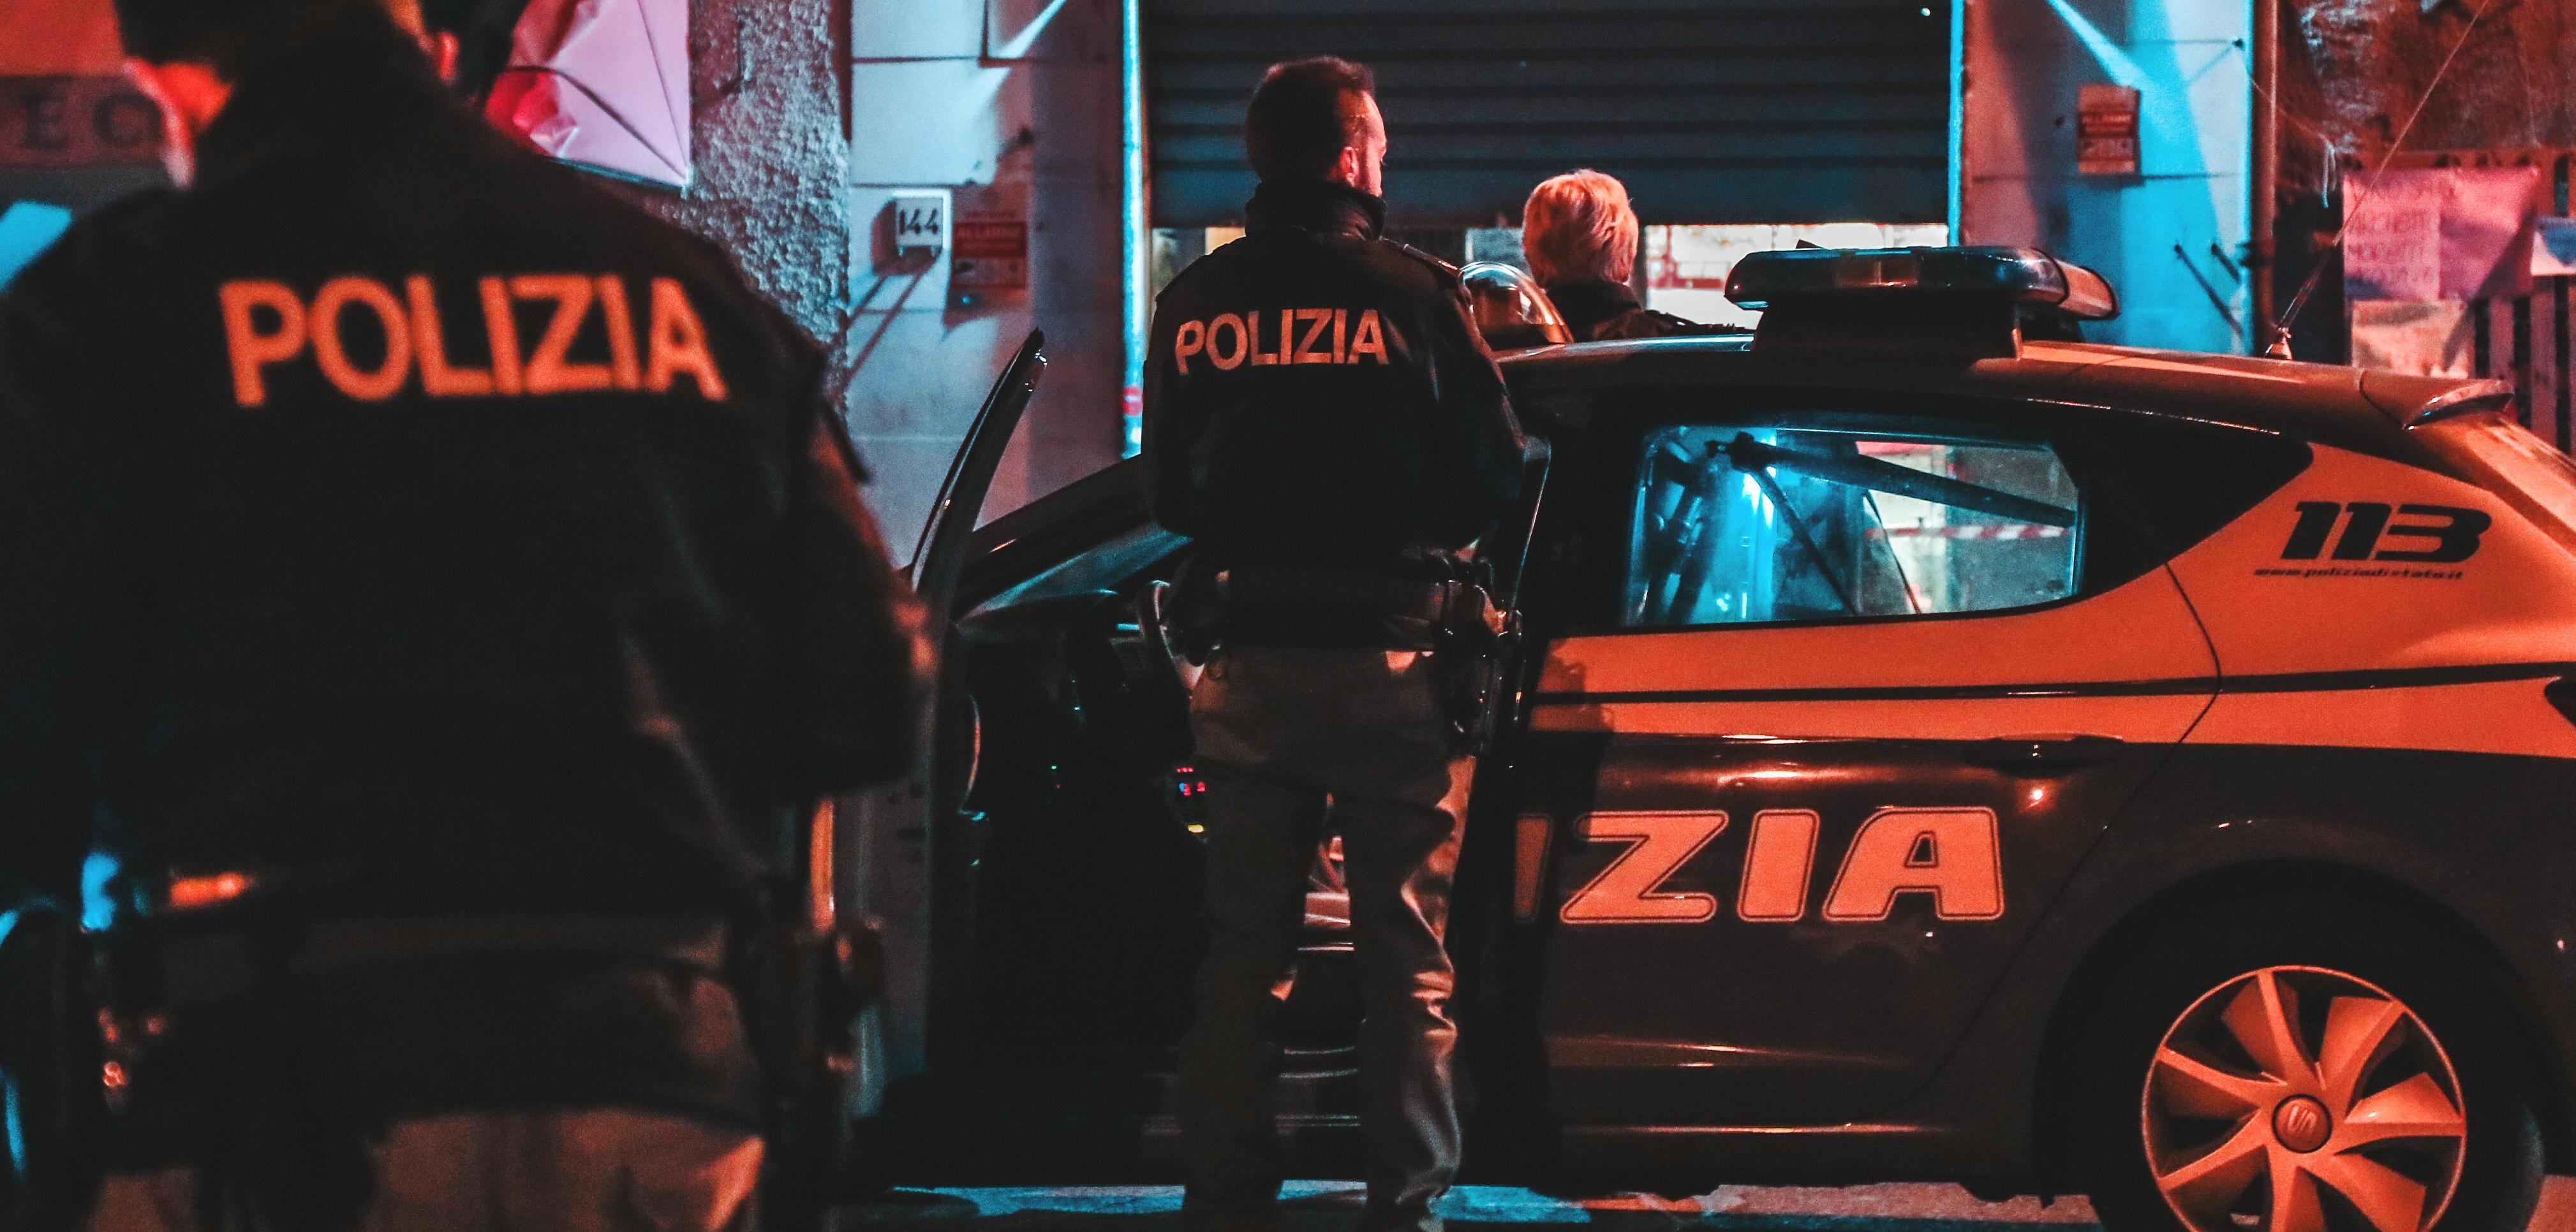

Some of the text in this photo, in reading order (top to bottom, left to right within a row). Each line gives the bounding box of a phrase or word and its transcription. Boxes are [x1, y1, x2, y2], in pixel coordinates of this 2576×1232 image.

[898, 208, 940, 235] 144
[220, 274, 727, 407] POLIZIA
[1175, 309, 1389, 376] POLIZIA
[2281, 501, 2492, 563] 113
